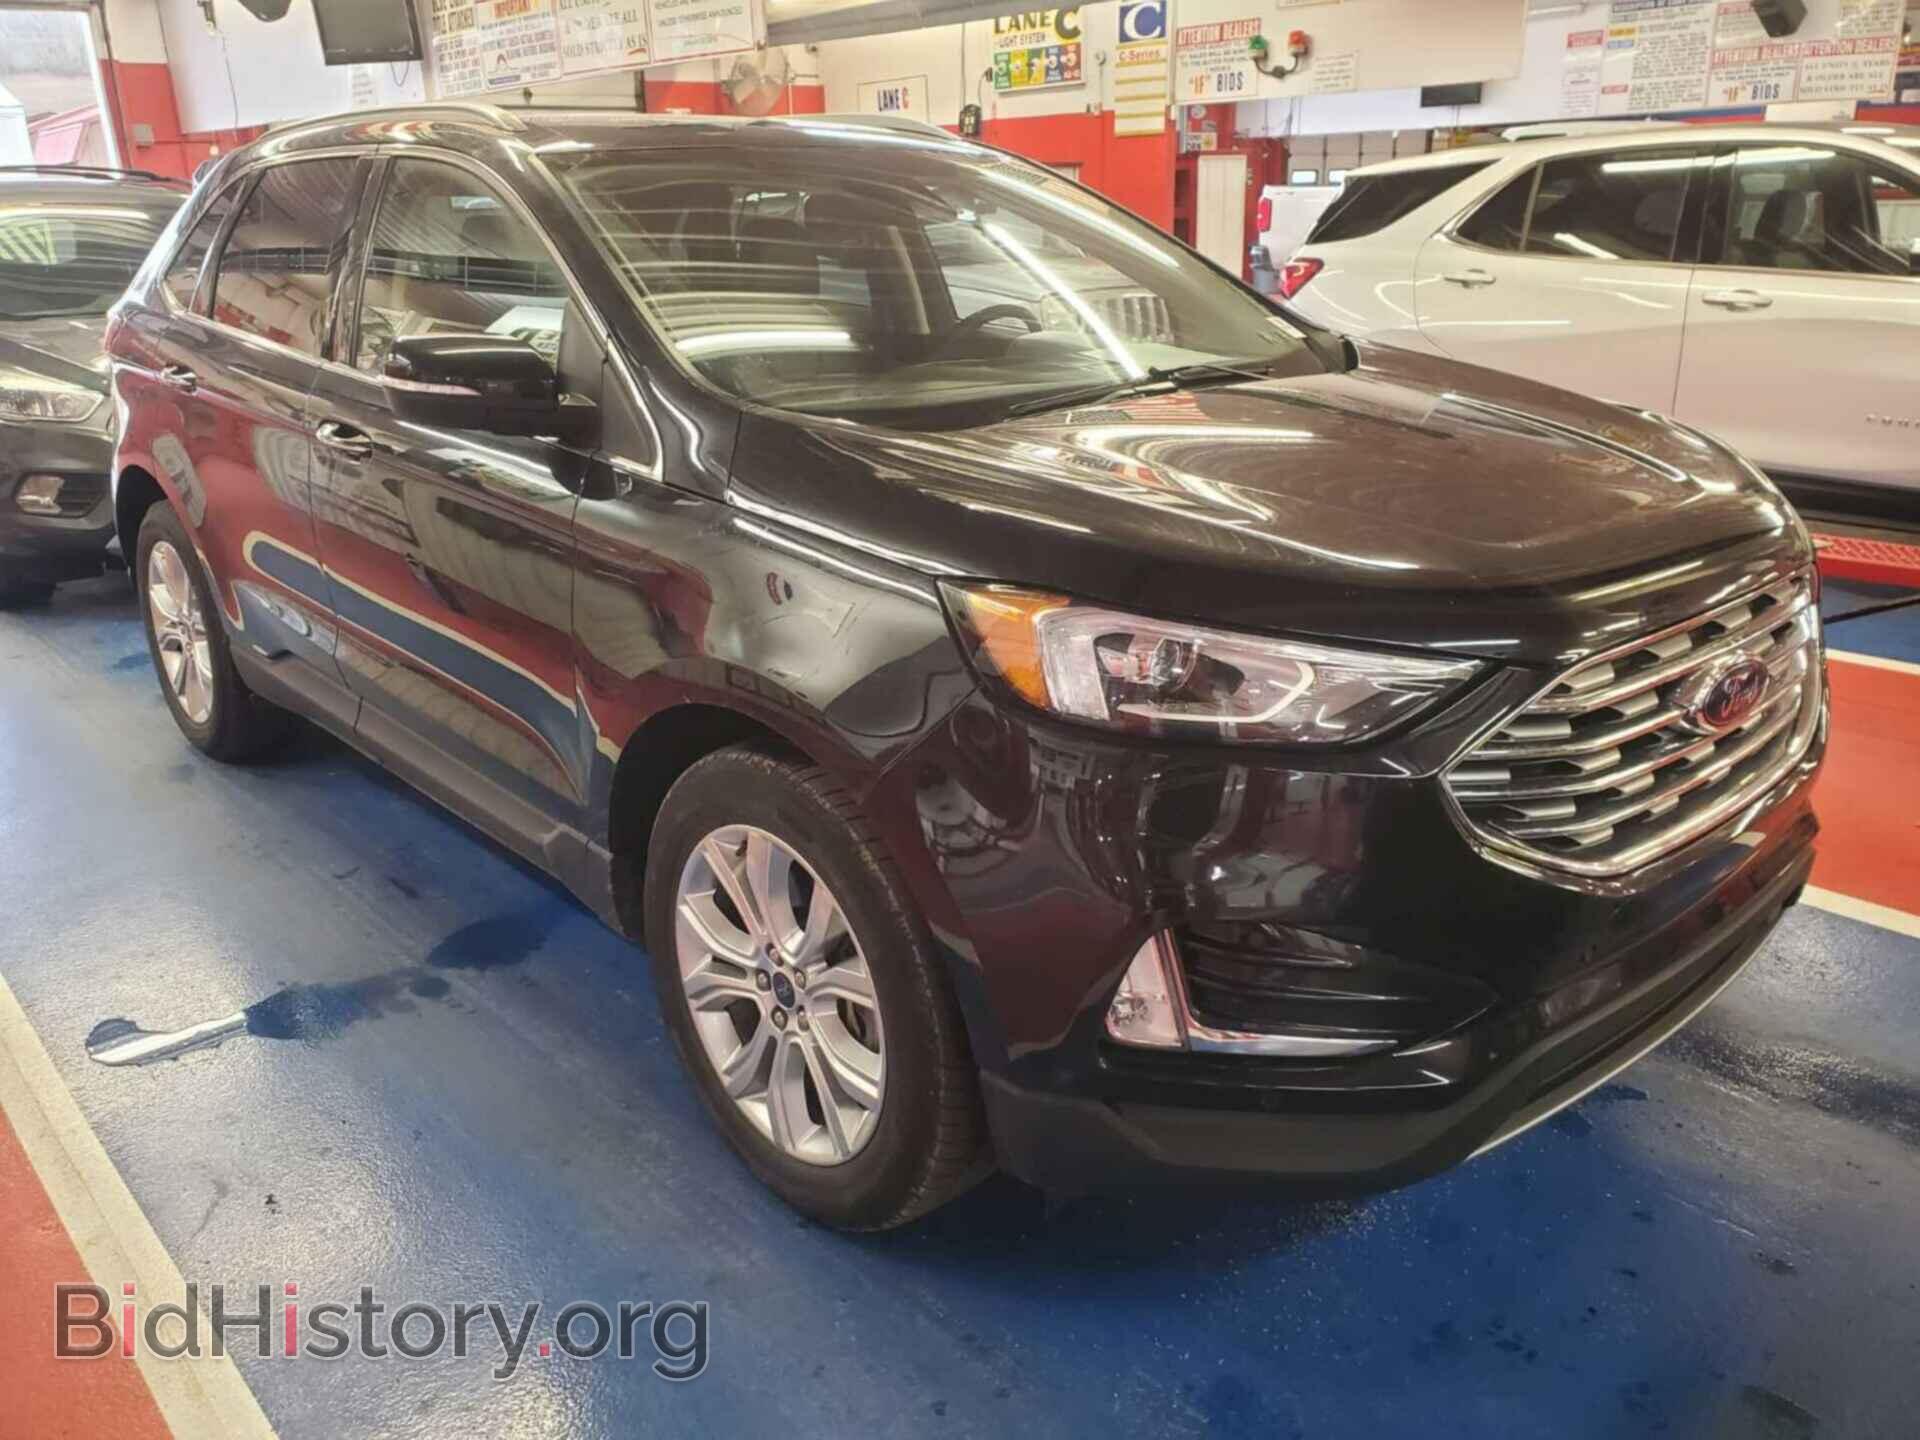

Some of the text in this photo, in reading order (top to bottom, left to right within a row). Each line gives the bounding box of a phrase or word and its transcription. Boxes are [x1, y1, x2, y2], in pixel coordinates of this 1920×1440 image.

[994, 7, 1082, 39] LANE C
[1124, 0, 1161, 39] C
[1119, 50, 1160, 61] C-Series
[1217, 72, 1243, 92] BIDS
[1751, 83, 1780, 100] BIDS
[877, 86, 909, 112] LANE C
